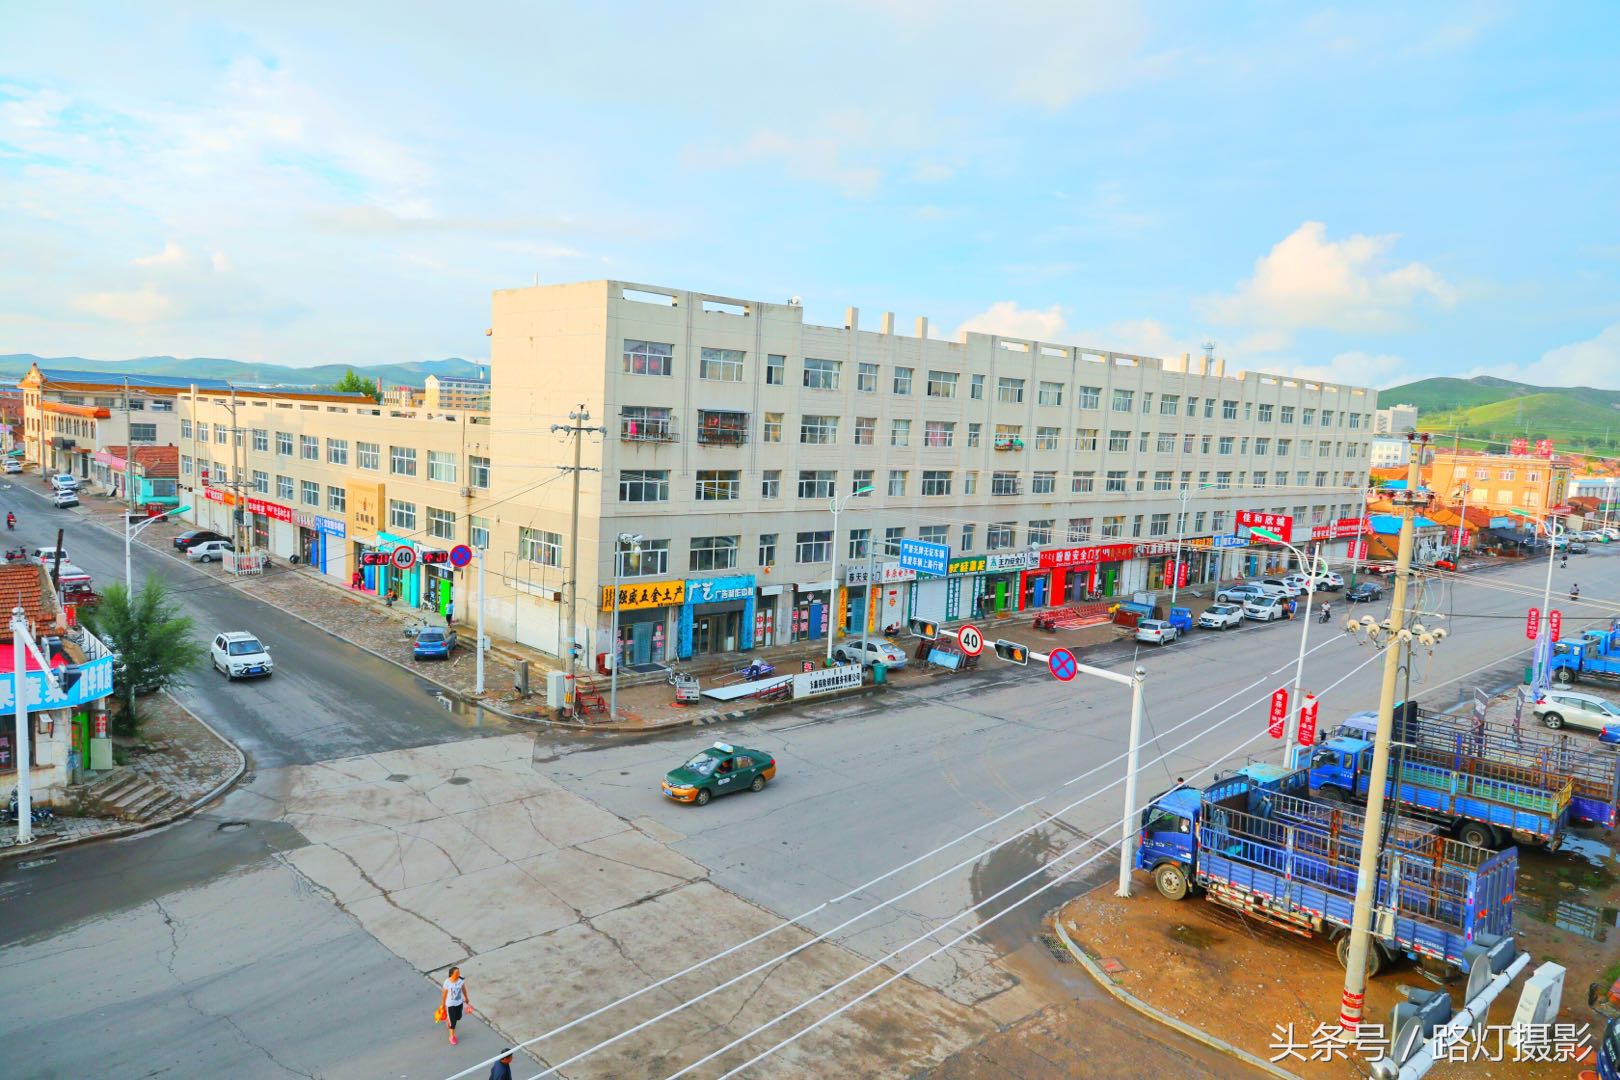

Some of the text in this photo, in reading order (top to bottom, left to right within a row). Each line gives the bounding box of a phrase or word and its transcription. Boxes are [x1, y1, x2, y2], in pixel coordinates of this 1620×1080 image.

[397, 552, 411, 563] 40
[688, 582, 714, 602] 广艺
[963, 632, 978, 648] 40
